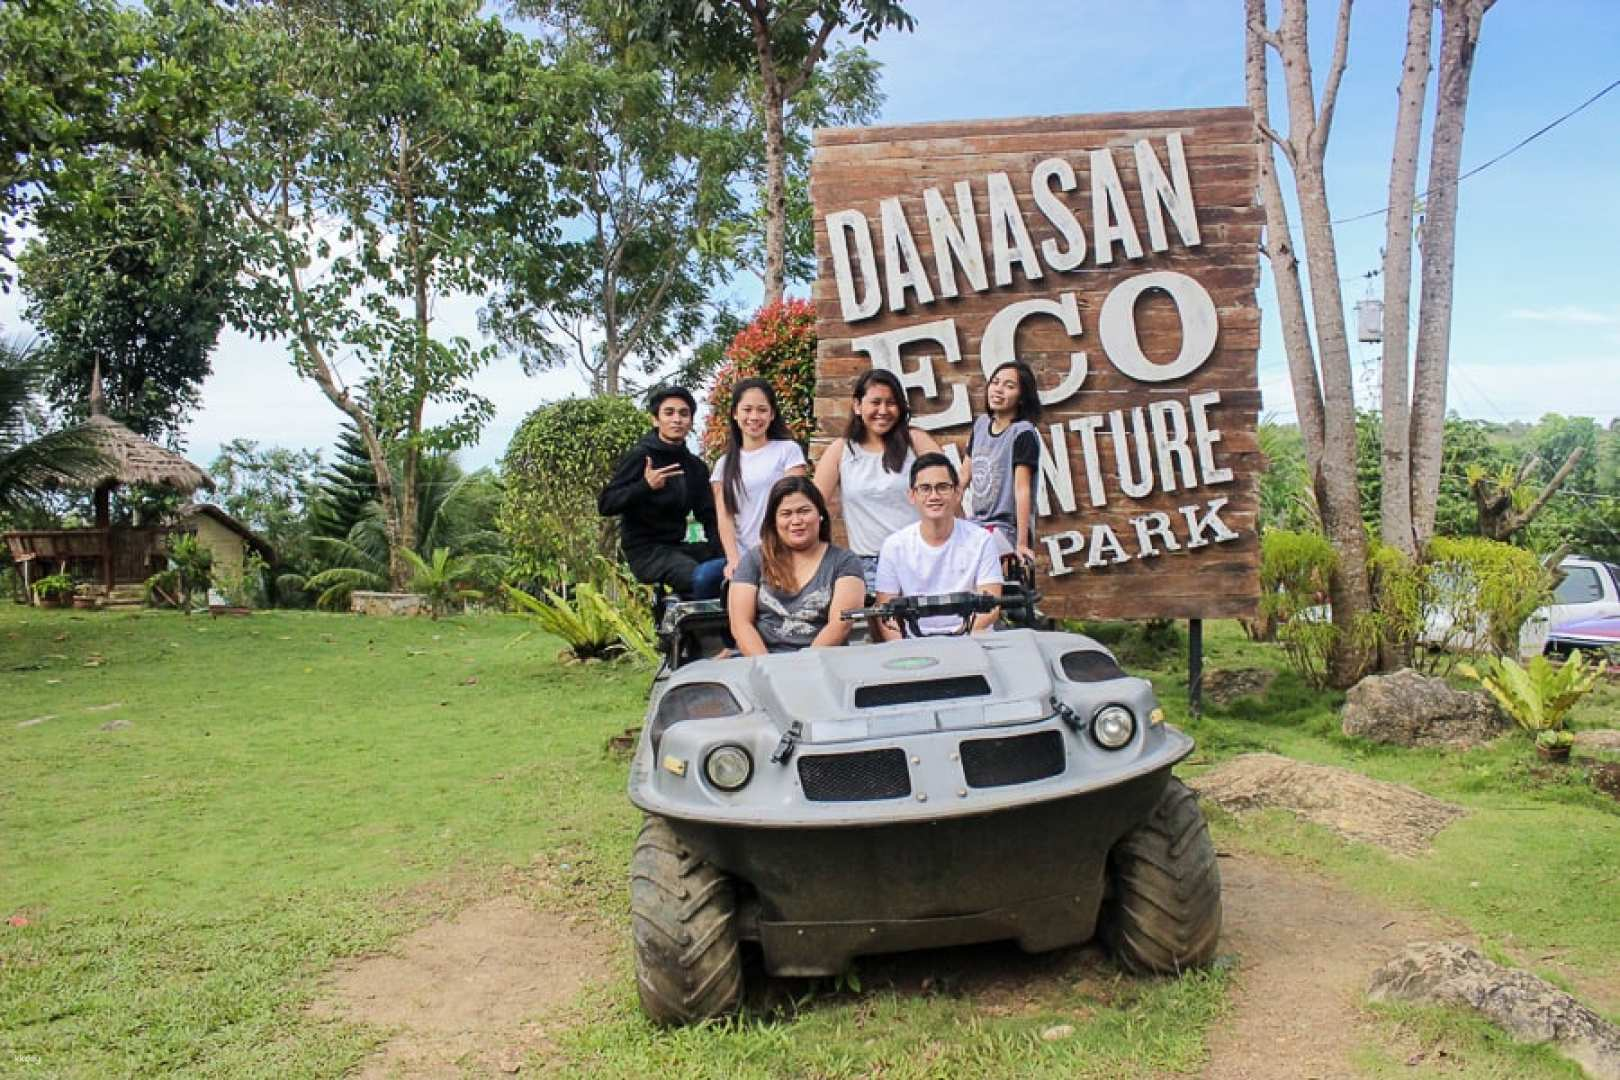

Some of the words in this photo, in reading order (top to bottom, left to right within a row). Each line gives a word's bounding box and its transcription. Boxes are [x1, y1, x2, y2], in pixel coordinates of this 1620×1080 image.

[825, 132, 1201, 323] DANASAN
[852, 271, 1219, 430] ECO
[942, 392, 1234, 518] NTURE
[1040, 498, 1239, 577] PARK
